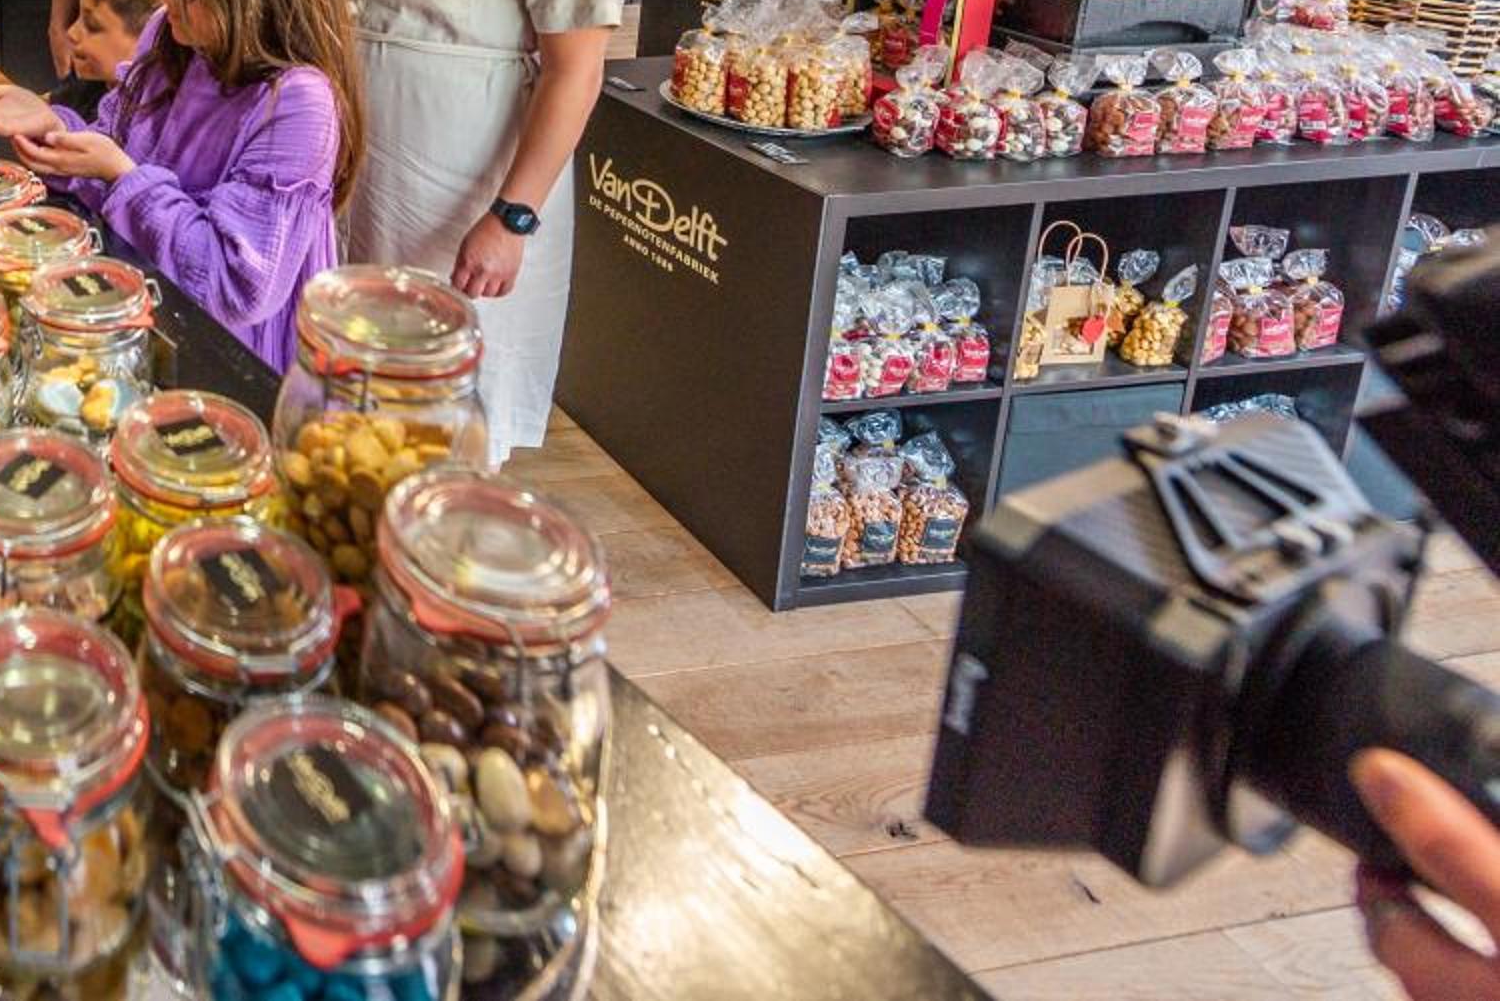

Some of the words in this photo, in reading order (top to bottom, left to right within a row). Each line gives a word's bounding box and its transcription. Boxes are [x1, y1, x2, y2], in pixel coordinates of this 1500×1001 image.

[589, 153, 632, 212] Van
[631, 178, 729, 262] Delft
[589, 194, 602, 211] DE
[603, 204, 720, 285] PEPERNOTENFABRIEK
[623, 234, 649, 256] ANNO
